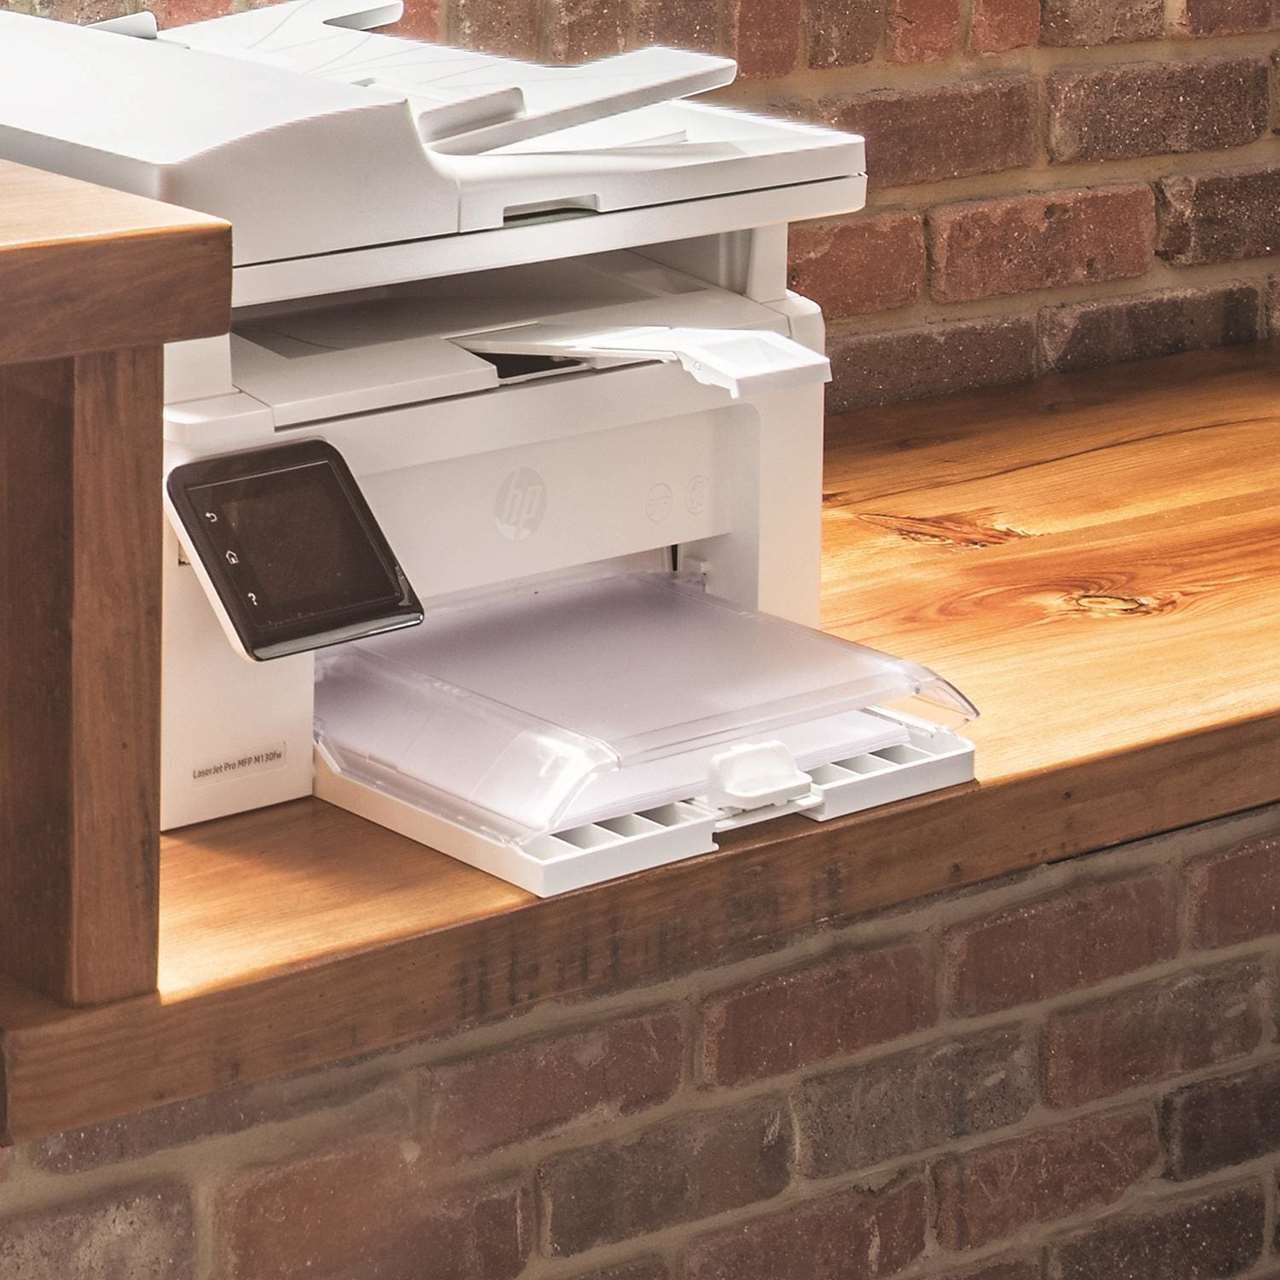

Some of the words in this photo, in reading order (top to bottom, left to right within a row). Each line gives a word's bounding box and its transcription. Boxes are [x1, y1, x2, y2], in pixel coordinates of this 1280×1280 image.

[192, 764, 223, 779] LaserJet
[223, 761, 236, 771] Pro
[238, 756, 253, 768] MFP
